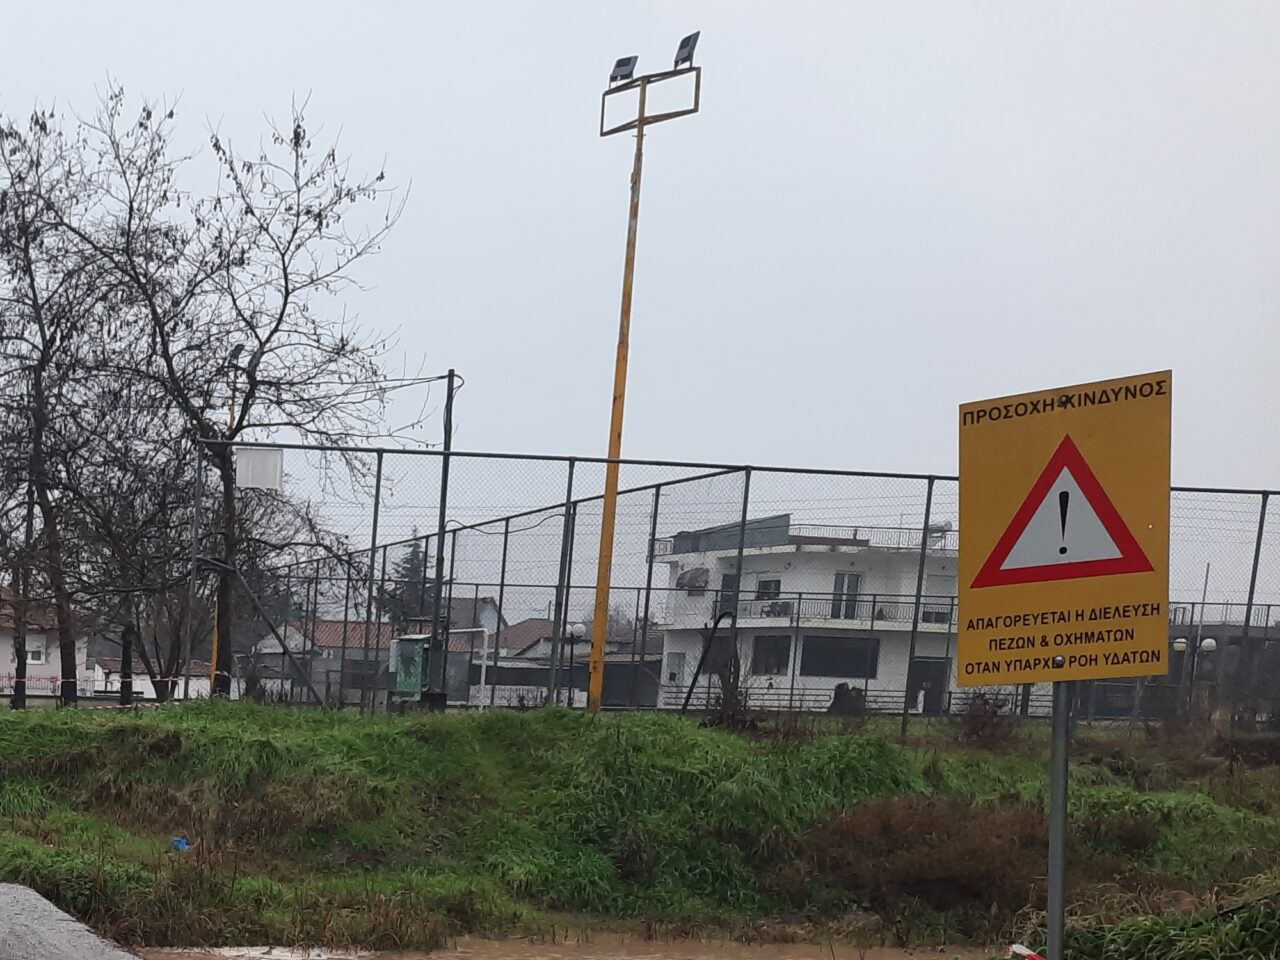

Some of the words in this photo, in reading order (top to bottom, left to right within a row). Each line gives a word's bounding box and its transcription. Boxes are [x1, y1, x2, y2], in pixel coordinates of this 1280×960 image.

[963, 398, 1055, 426] ΠΡΟΣΟΧΗ
[966, 610, 1071, 632] ΑΠΑΓΟΡΕΥΕΤΑΙ
[1075, 609, 1085, 622] Η
[1088, 602, 1161, 621] ΔΙΕΛΕΥΣΗ
[989, 635, 1036, 652] ΠΕΖΩΝ
[1040, 633, 1049, 648] &
[1053, 628, 1135, 647] ΟΧΗΜΑΤΩΝ
[965, 661, 1001, 675] ΟΤΑΝ
[1004, 656, 1064, 673] ΥΠΑΡΧΕ
[1069, 654, 1098, 669] ΡΟΗ
[1102, 649, 1161, 666] ΥΔΑΤΩΝ
